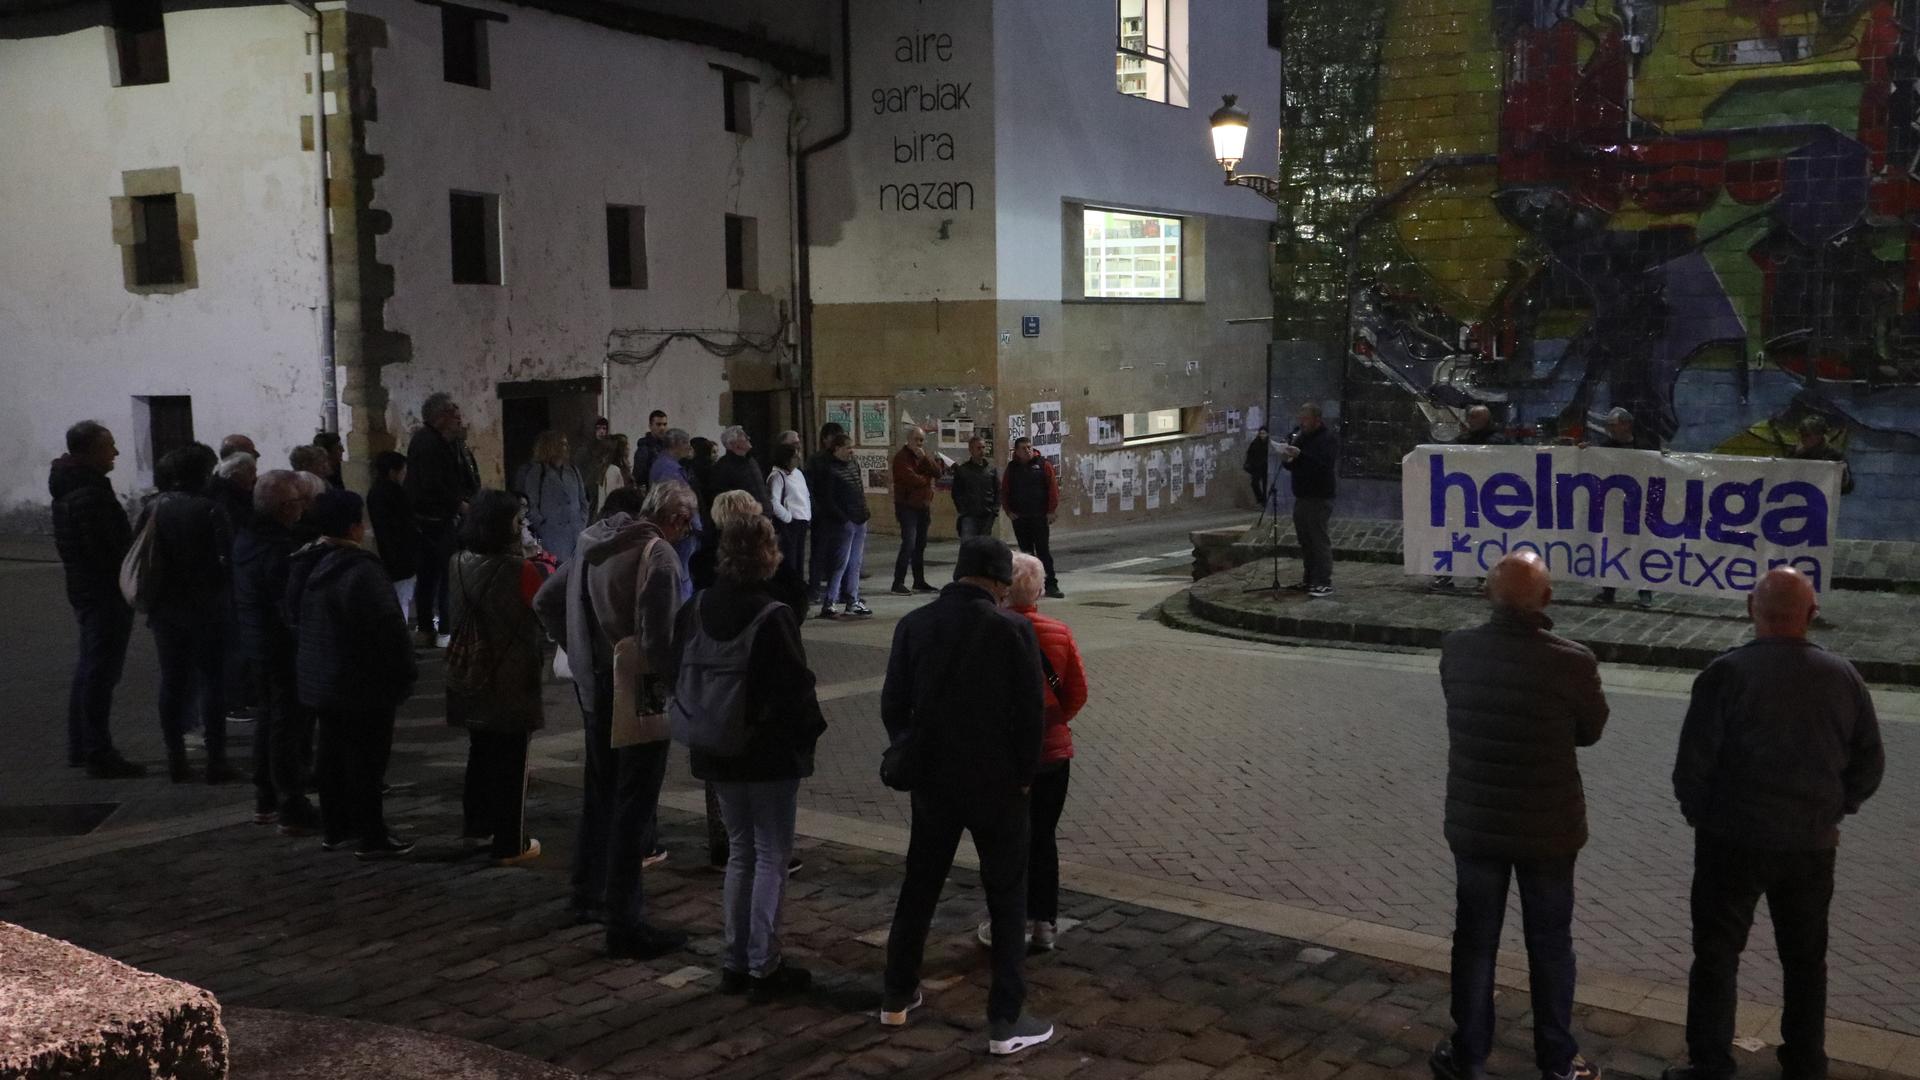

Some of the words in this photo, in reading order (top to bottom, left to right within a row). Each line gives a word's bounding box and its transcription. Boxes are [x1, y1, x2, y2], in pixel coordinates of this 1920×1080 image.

[895, 29, 953, 64] aire
[871, 78, 972, 115] garbiak
[894, 130, 955, 164] bira
[879, 180, 975, 211] nazan
[1429, 453, 1829, 551] helmuga
